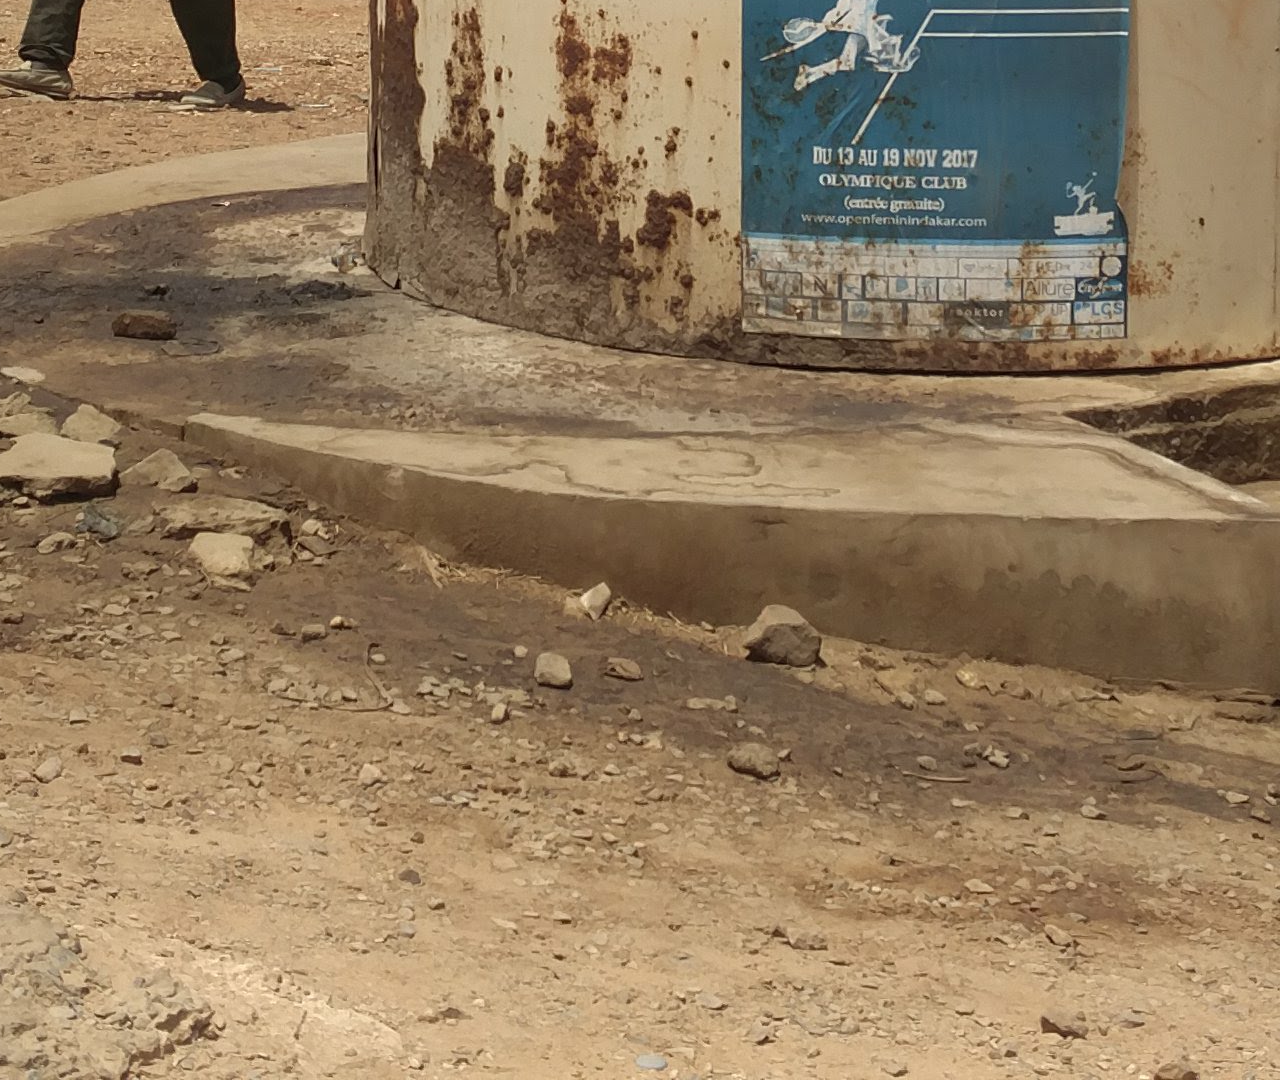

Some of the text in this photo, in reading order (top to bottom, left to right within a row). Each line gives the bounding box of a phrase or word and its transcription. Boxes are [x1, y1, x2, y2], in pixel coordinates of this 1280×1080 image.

[813, 146, 978, 168] DU 13 AU 19 NOV 2017
[819, 174, 967, 190] OLYMPIQUE CLUB
[801, 213, 987, 228] www.openfeminindakar.com
[1091, 301, 1123, 316] LCS
